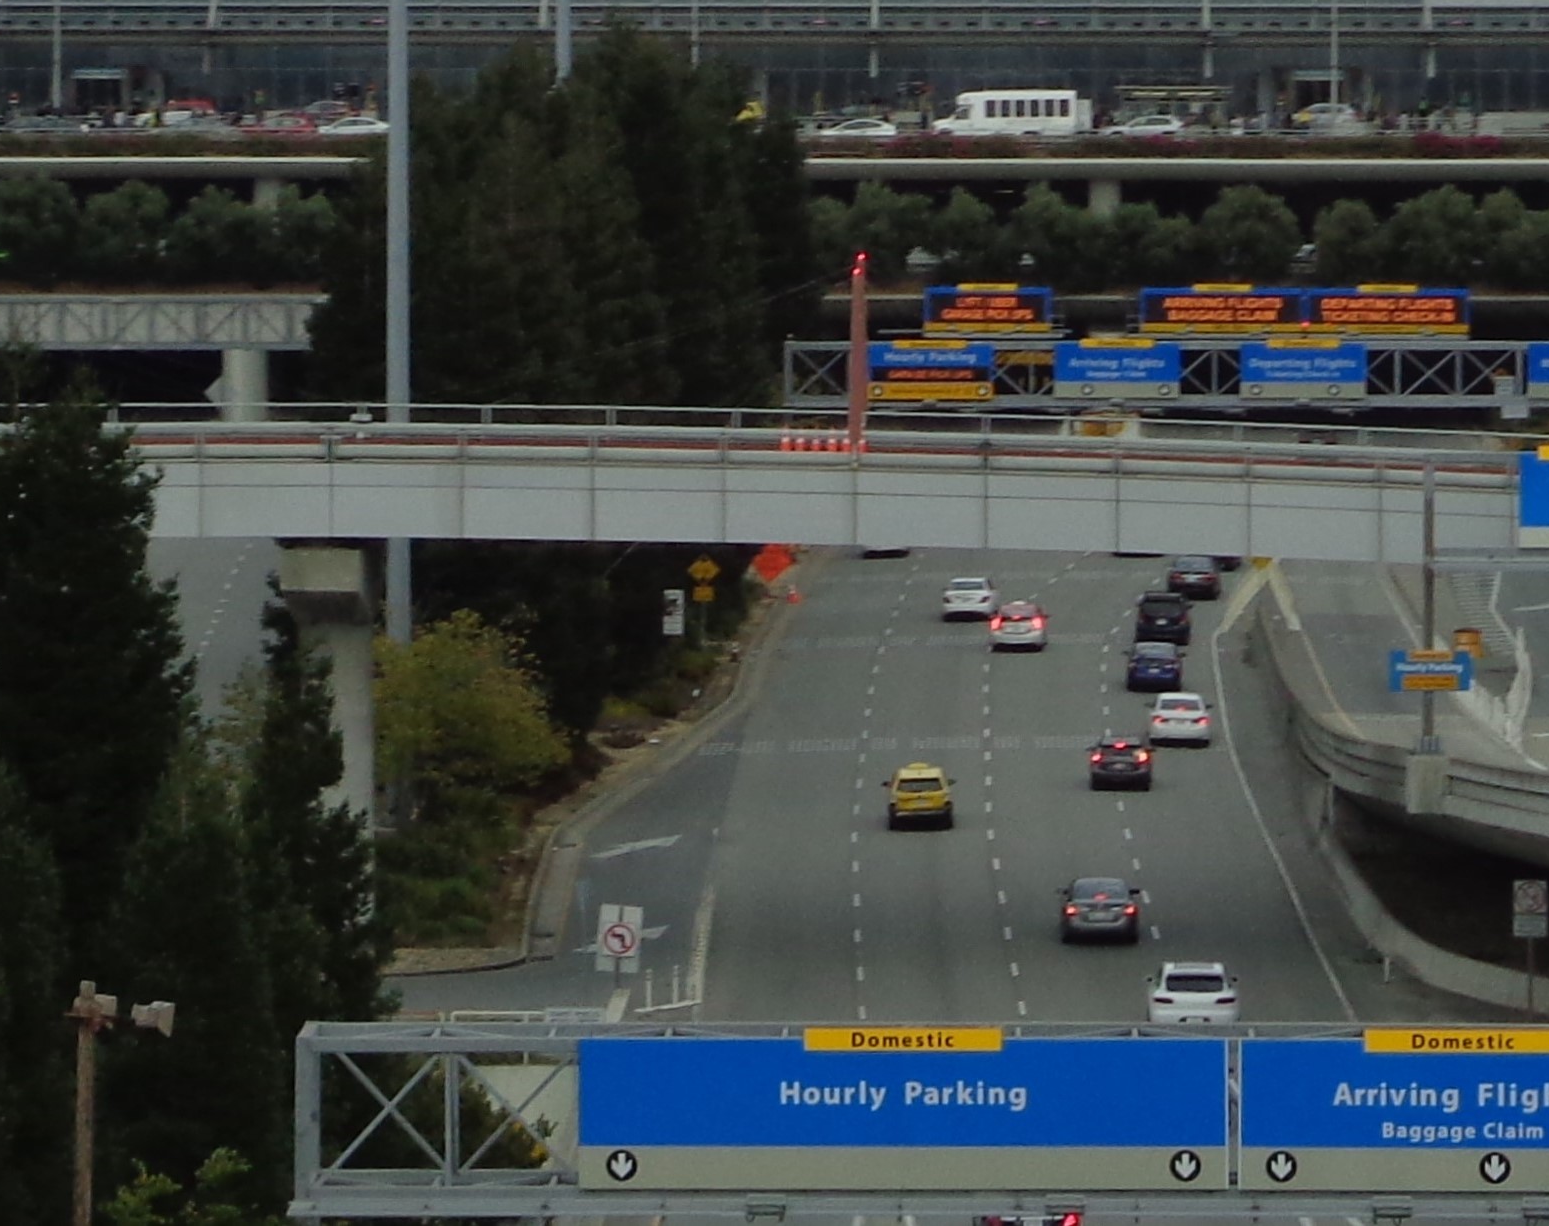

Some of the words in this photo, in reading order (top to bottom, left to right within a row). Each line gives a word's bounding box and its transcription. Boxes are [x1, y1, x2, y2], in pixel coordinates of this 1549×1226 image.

[850, 1031, 956, 1049] Domestic
[1411, 1033, 1516, 1051] Domestic
[779, 1080, 887, 1111] Hourly
[903, 1080, 1028, 1112] Parking
[1333, 1081, 1460, 1114] Arriving
[1381, 1121, 1477, 1143] Baggage
[1483, 1121, 1545, 1140] Claim
